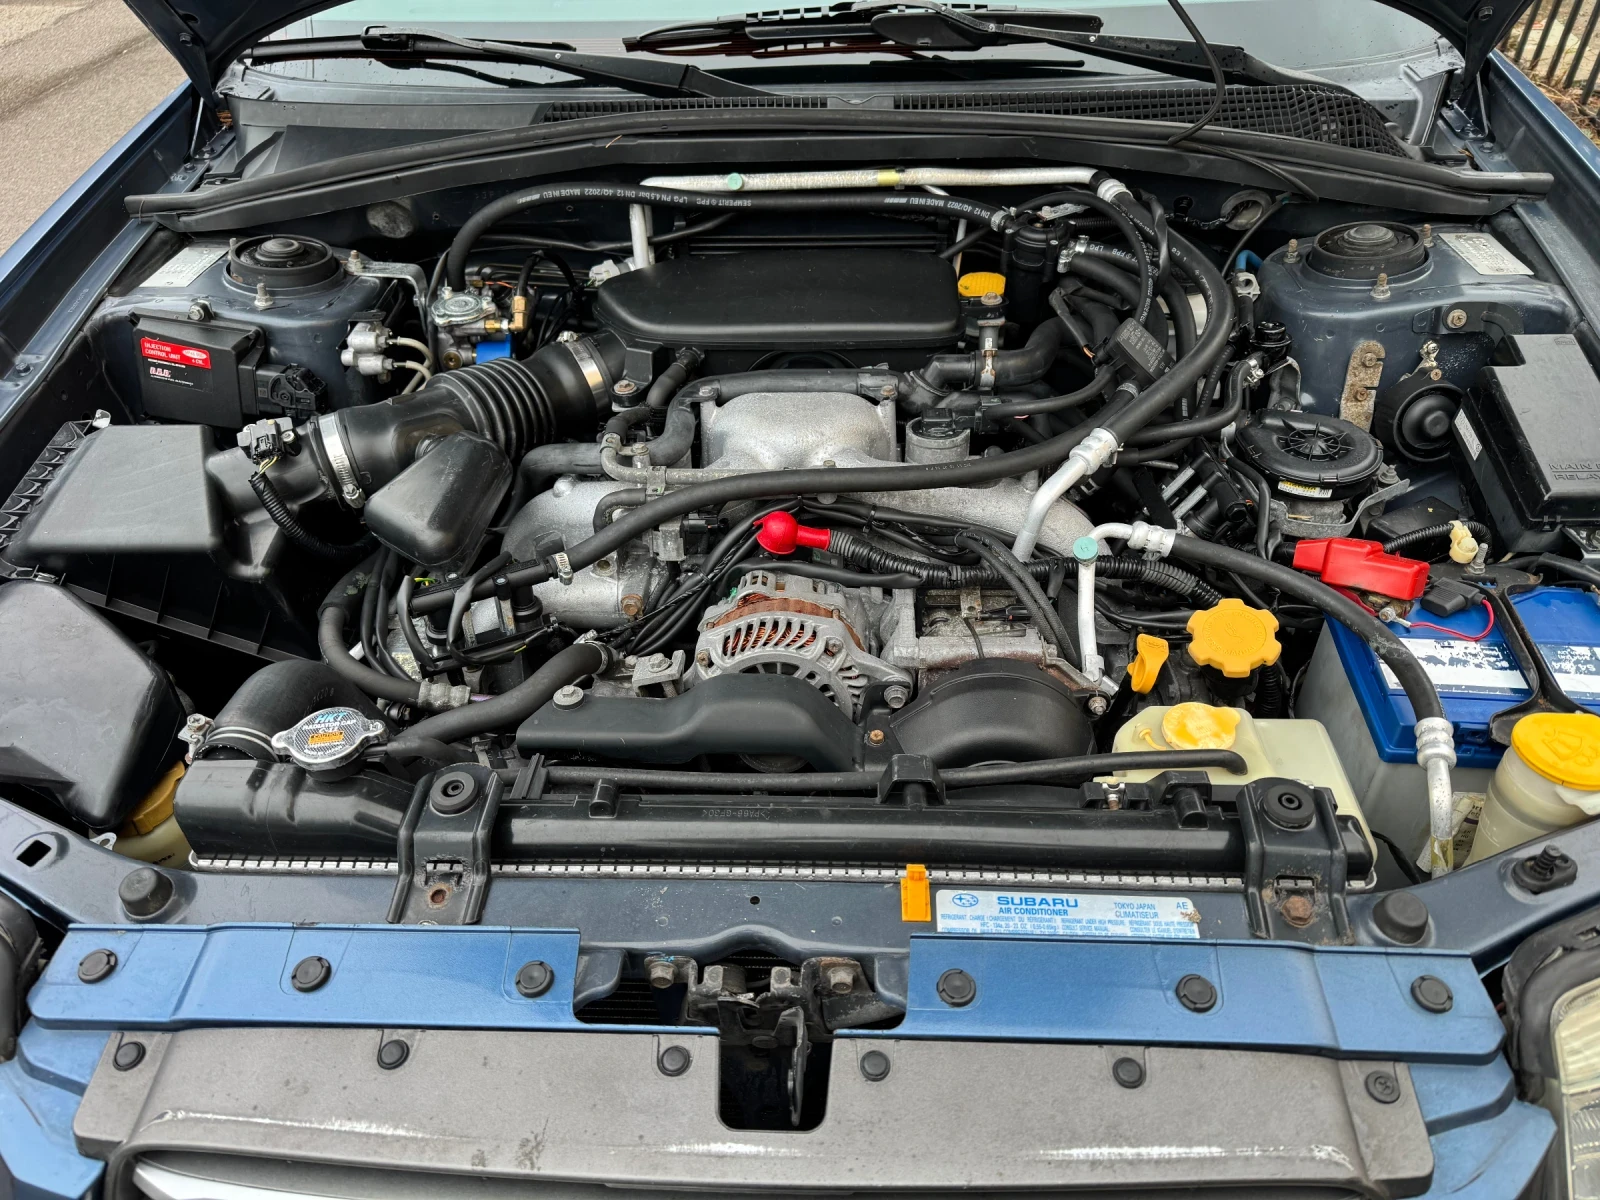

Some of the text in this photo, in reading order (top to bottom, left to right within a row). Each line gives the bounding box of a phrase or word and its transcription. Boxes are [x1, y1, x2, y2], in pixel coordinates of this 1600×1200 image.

[638, 191, 650, 200] bar
[650, 193, 660, 201] 4.5
[674, 195, 688, 203] LPG
[718, 199, 751, 207] SEMPERIT
[1089, 244, 1104, 252] LPG
[144, 342, 172, 352] INJECTION
[144, 348, 168, 358] CONTROL
[315, 711, 347, 724] HKT
[302, 721, 340, 730] RADIATOR
[997, 896, 1079, 908] SUBARU
[1113, 902, 1134, 910] TOKYO
[1176, 901, 1189, 910] AE
[998, 907, 1069, 916] AIR CONDITIONER
[1115, 910, 1159, 919] CLIMATISEUR
